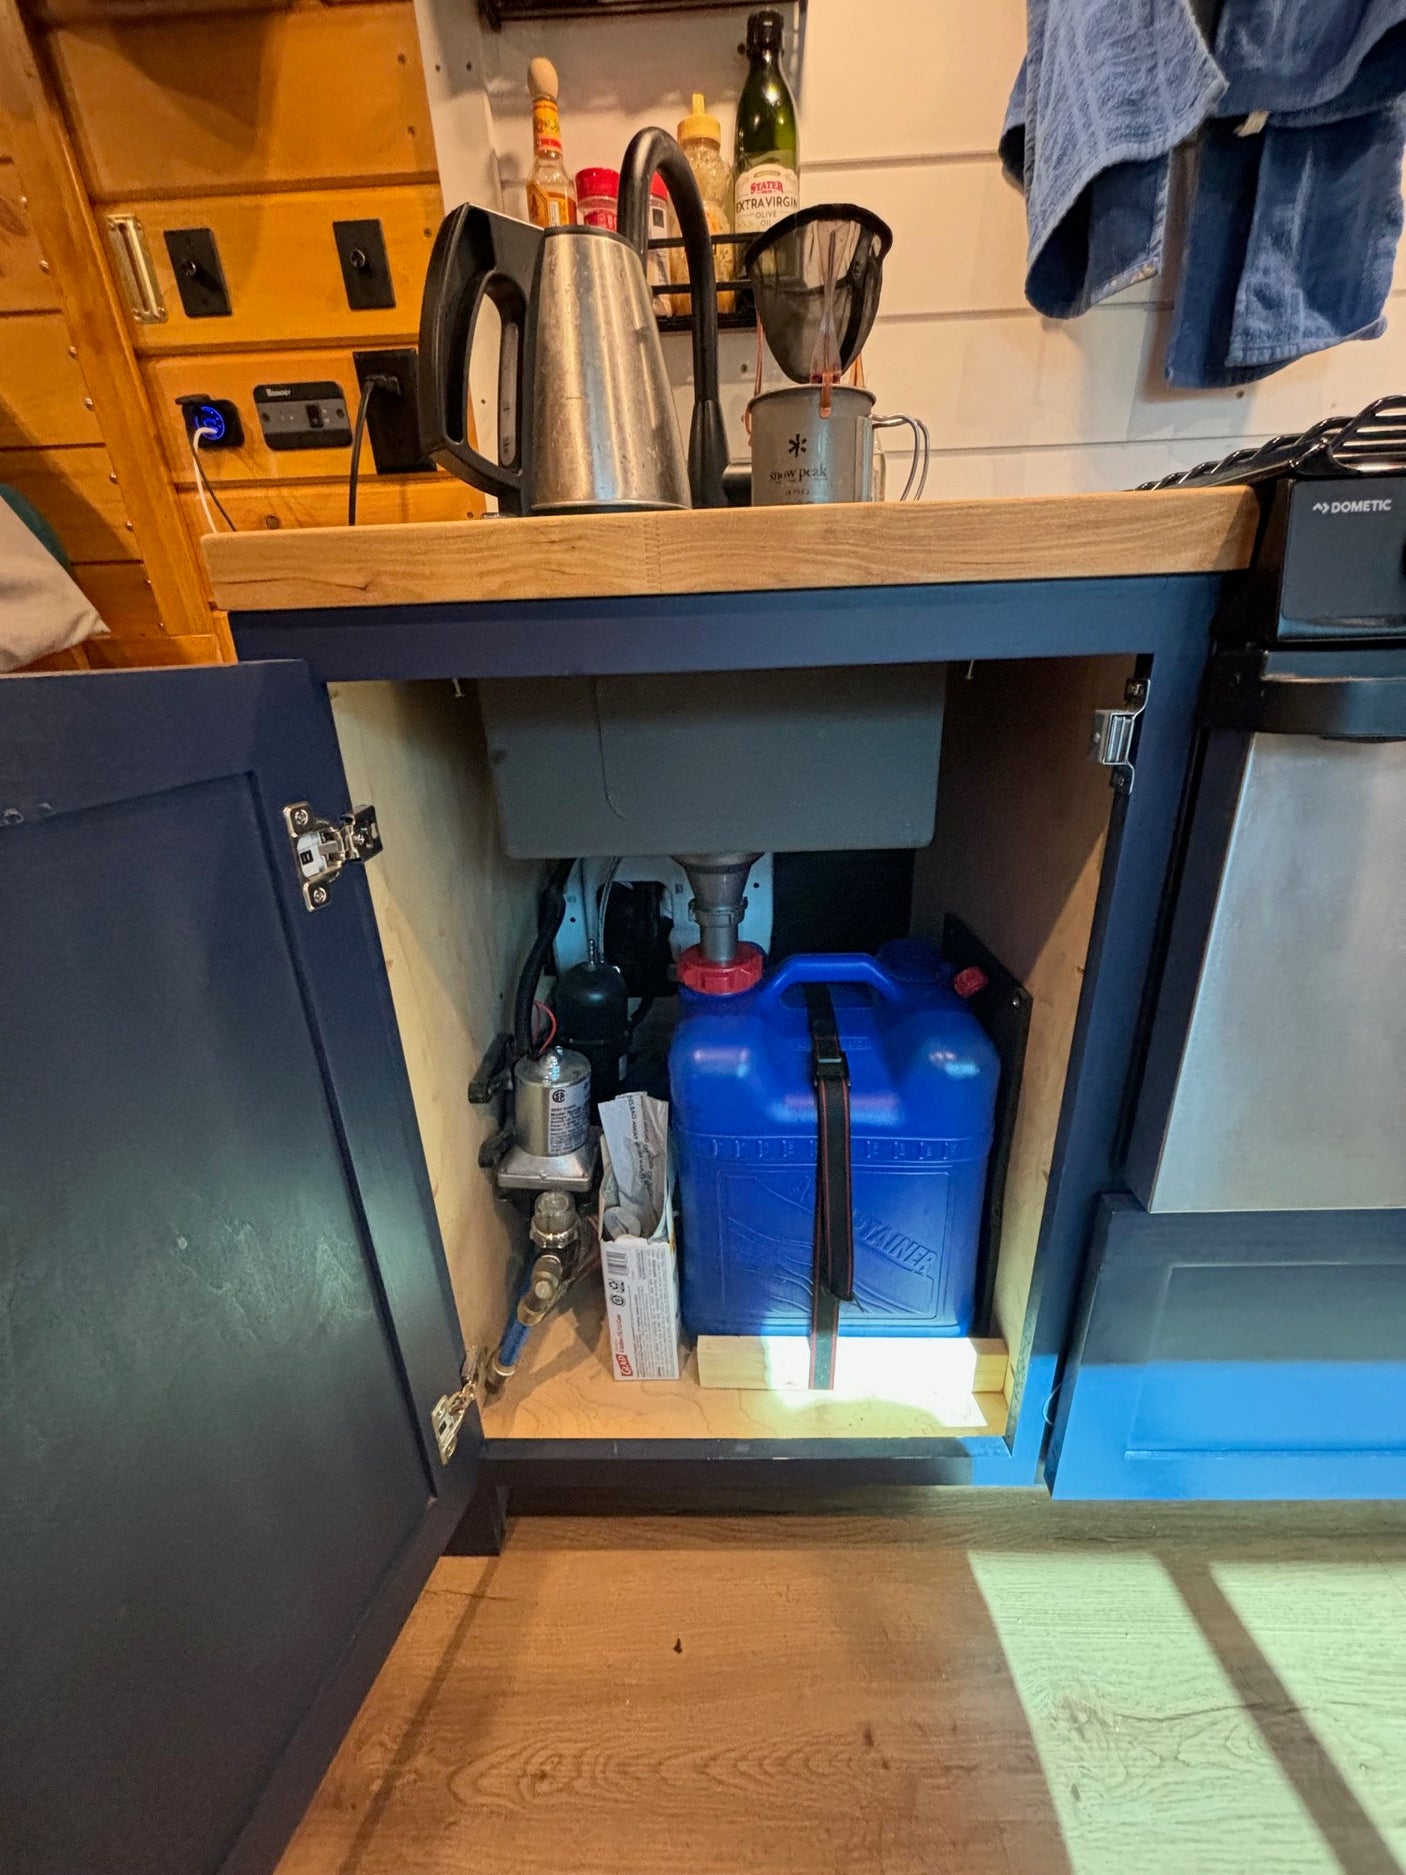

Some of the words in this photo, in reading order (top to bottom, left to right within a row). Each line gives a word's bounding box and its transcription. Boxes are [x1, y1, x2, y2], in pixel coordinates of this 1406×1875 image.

[751, 181, 784, 195] STATER
[755, 210, 777, 219] OLIVE
[1331, 499, 1392, 514] DOMETIC
